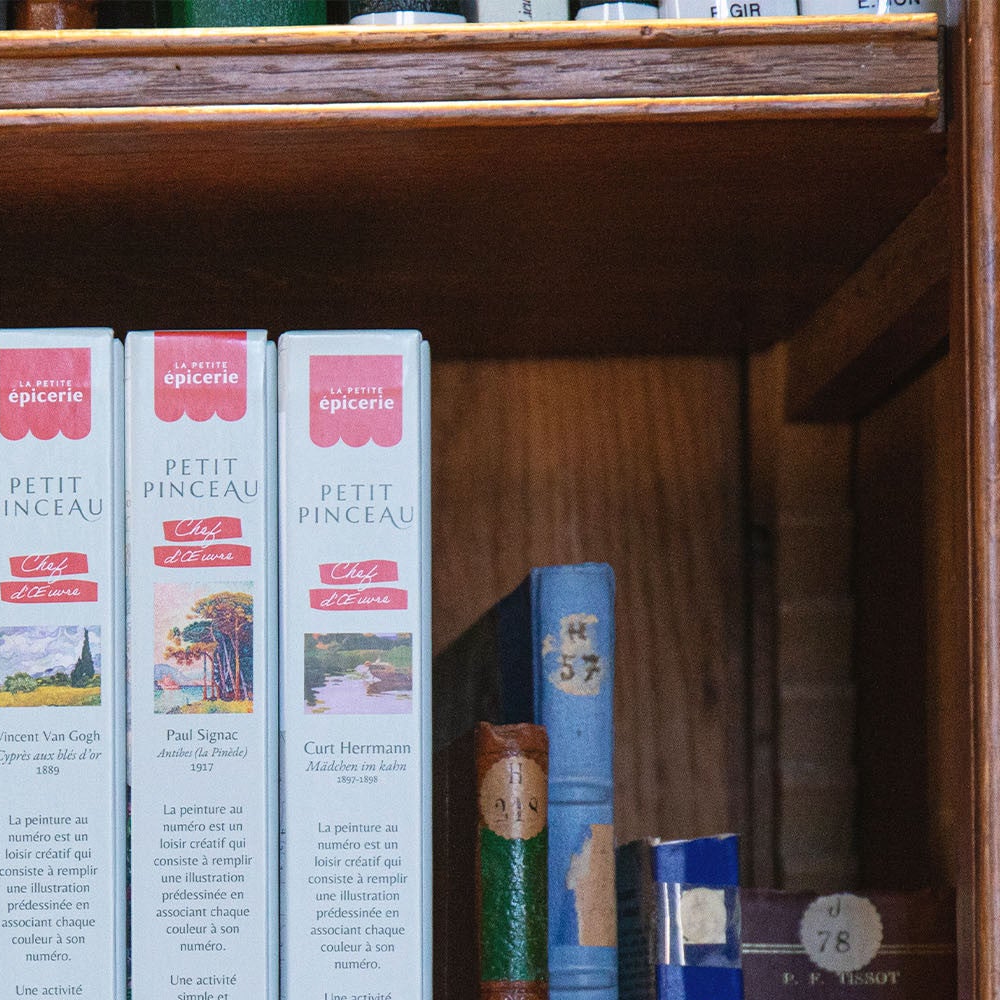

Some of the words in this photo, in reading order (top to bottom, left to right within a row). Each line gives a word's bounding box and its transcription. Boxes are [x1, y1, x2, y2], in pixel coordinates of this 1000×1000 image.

[730, 3, 761, 18] GIR
[173, 361, 188, 369] LA
[190, 360, 229, 369] PETITE
[163, 368, 239, 389] épicerie
[8, 387, 84, 408] épicerie
[319, 394, 395, 415] épicerie
[165, 457, 238, 476] PETIT
[10, 476, 82, 495] PETIT
[143, 479, 258, 504] PINCEAU
[321, 483, 393, 502] PETIT
[298, 506, 414, 530] PINCEAU
[21, 554, 68, 584] Chef
[331, 562, 378, 592] Chef
[42, 730, 65, 742] Van
[68, 729, 101, 745] Gogh
[166, 728, 193, 742] Paul
[197, 728, 239, 745] Signac
[32, 752, 55, 761] aux
[56, 748, 77, 761] blés
[156, 747, 193, 759] Antibes
[194, 746, 209, 760] (la
[211, 746, 248, 760] Pinède)
[303, 740, 335, 755] Curt
[340, 741, 411, 755] Herrmann
[36, 764, 60, 776] 1889
[190, 762, 214, 773] 1917
[304, 759, 358, 772] Mädchen
[361, 763, 376, 772] im
[378, 759, 407, 772] kahn
[336, 775, 379, 785] 1897-1898
[817, 929, 851, 954] 78
